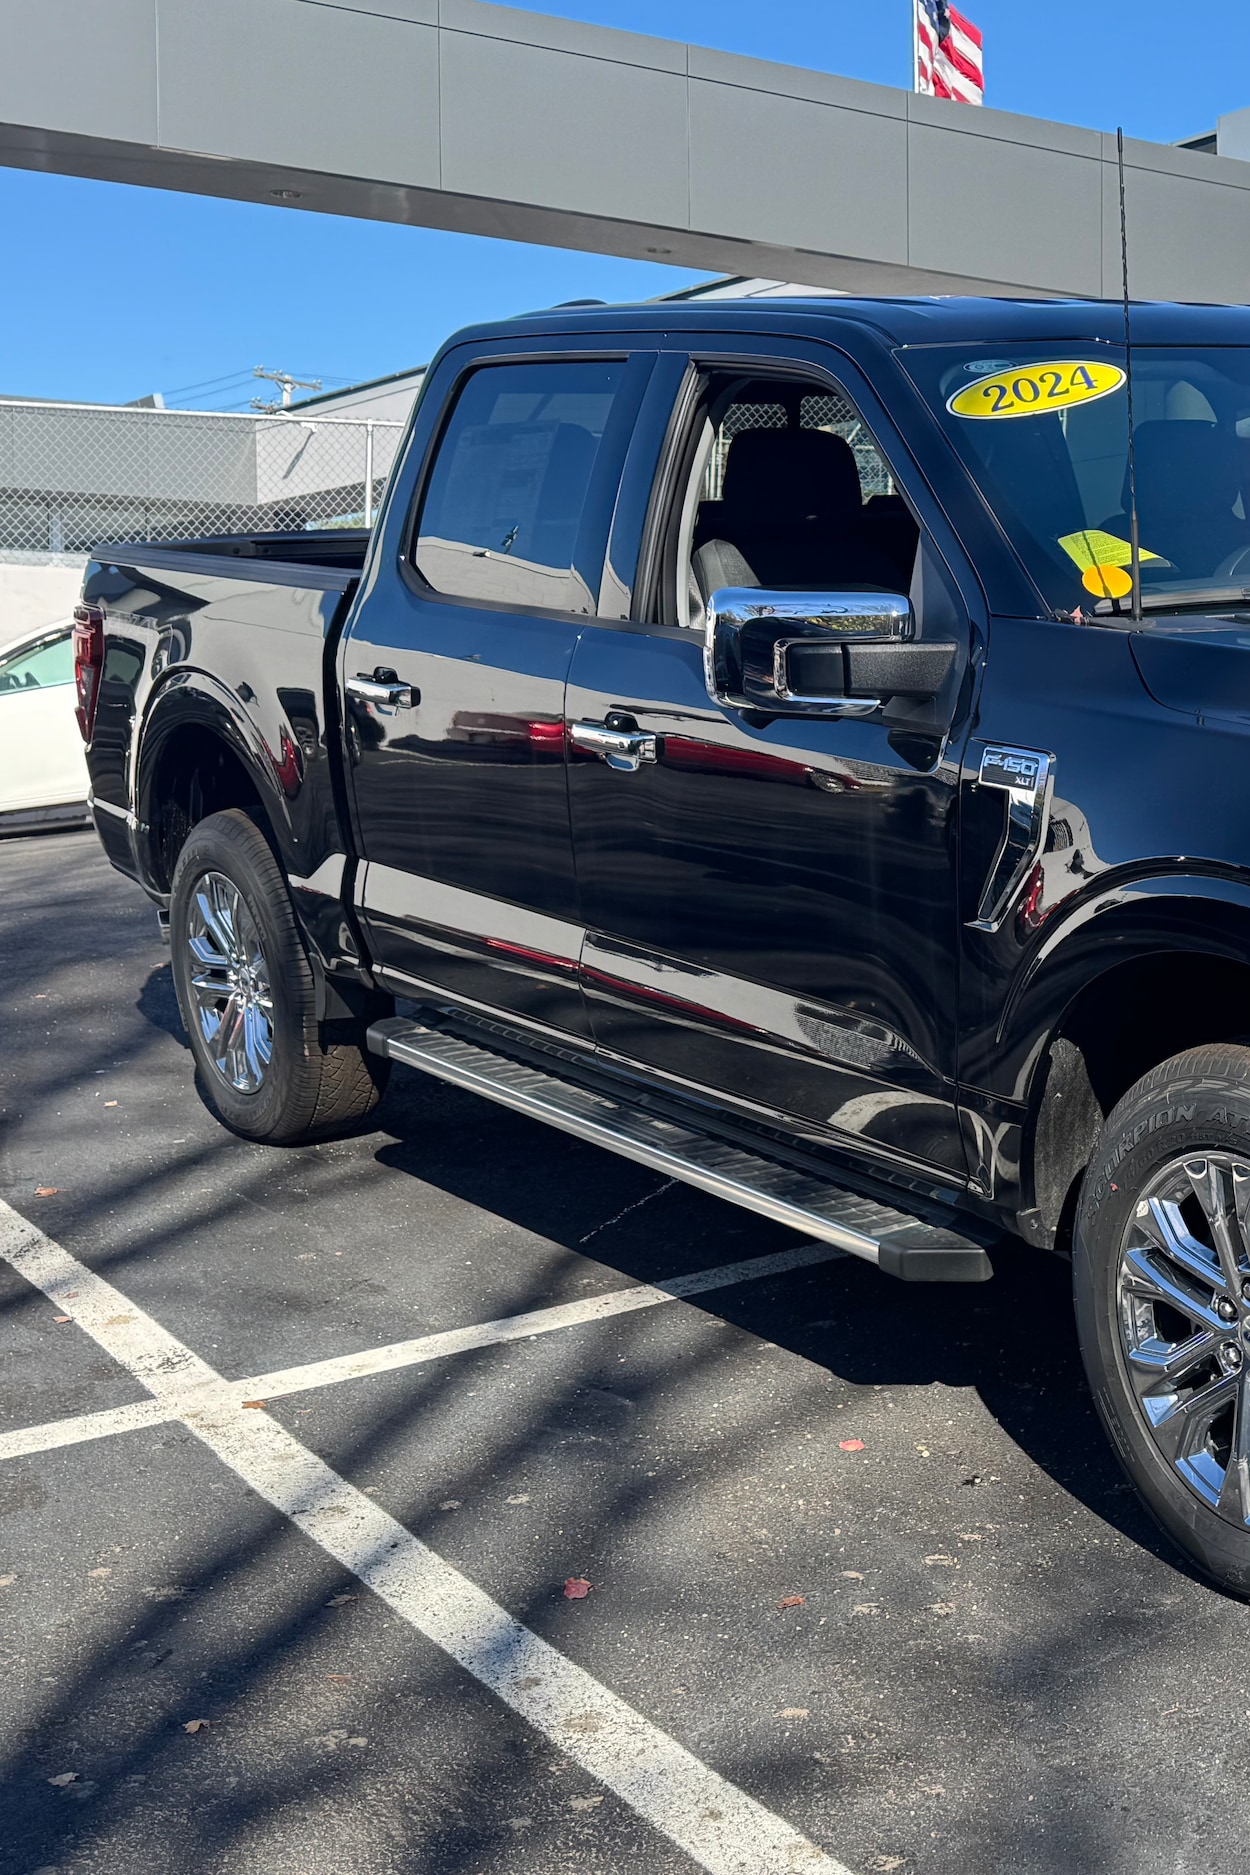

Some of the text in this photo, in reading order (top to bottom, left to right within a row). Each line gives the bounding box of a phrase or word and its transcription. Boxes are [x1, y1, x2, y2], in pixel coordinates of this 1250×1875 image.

[982, 366, 1099, 412] 2024
[983, 754, 1038, 776] F-150
[1015, 776, 1031, 786] XLT
